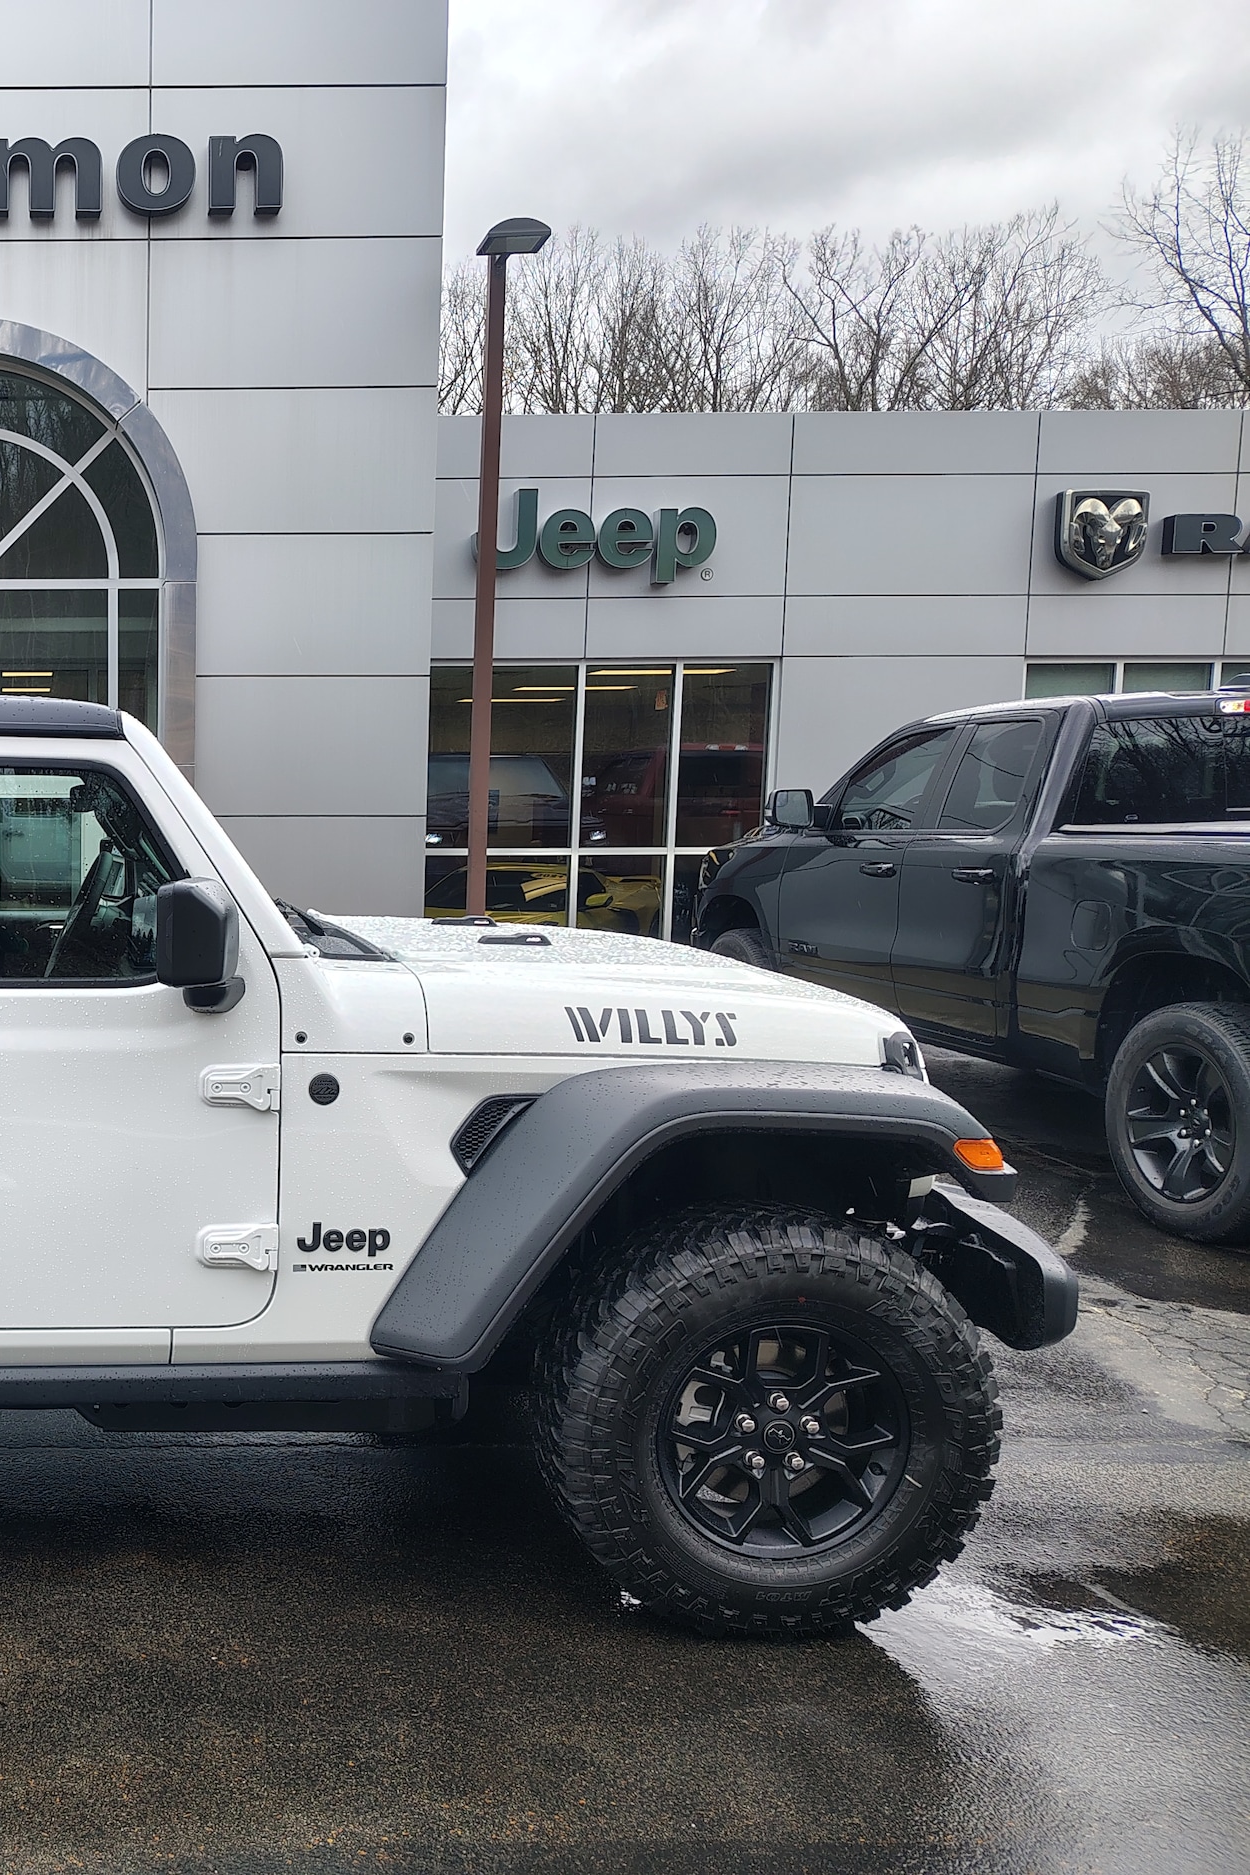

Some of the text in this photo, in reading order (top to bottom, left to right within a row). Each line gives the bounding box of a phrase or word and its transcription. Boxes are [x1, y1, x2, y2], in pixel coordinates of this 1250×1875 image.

[470, 488, 718, 585] Jeep
[1161, 513, 1250, 555] R
[564, 1006, 737, 1047] WILLYS
[296, 1222, 391, 1257] Jeep
[308, 1263, 394, 1272] WRANGLER
